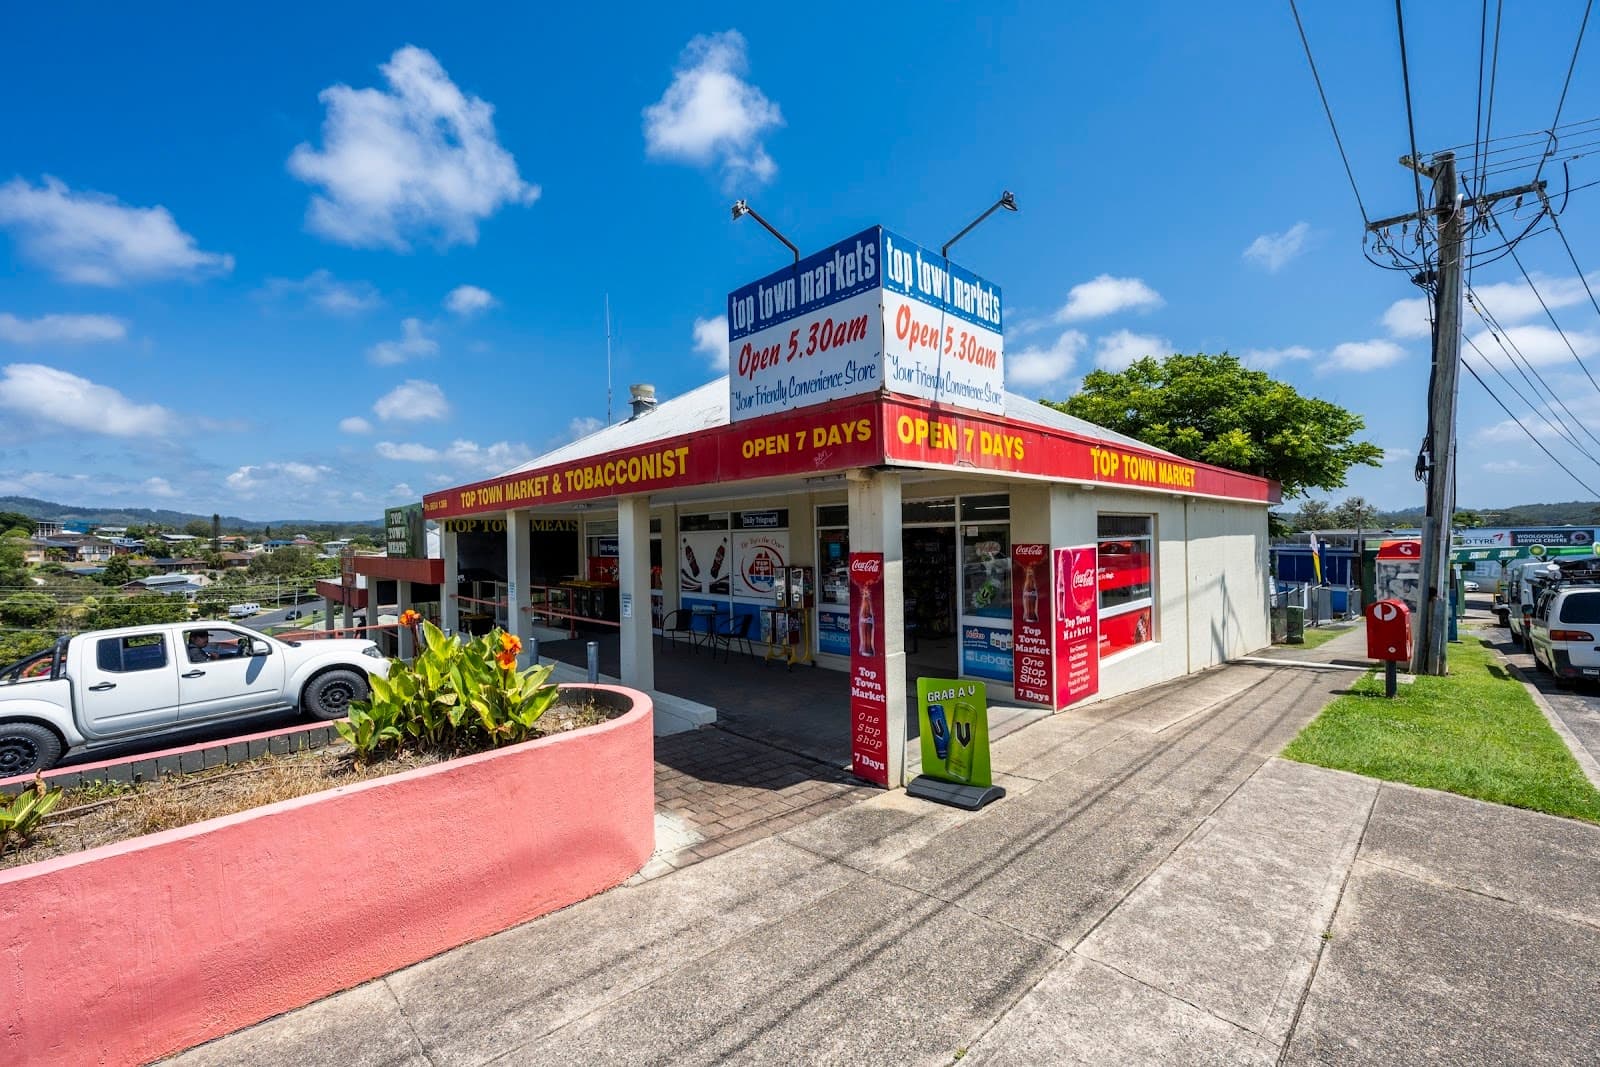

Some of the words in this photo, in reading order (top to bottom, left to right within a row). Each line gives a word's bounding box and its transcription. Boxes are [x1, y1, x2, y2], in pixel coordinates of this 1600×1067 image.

[733, 295, 755, 332] top
[759, 278, 796, 320] town
[800, 240, 876, 304] markets
[886, 237, 913, 289] top
[916, 248, 951, 305] town
[953, 276, 1001, 325] markets
[896, 304, 940, 352] Open
[944, 325, 997, 370] 5.30am
[738, 342, 781, 381] Open
[787, 316, 868, 362] 5.30am
[755, 380, 788, 406] Friendly
[789, 370, 844, 399] Convenience
[946, 371, 984, 400] Convenience
[742, 432, 790, 459] OPEN
[796, 431, 807, 449] 7
[813, 419, 872, 449] DAYS
[897, 415, 958, 451] OPEN
[964, 428, 975, 453] 7
[979, 431, 1025, 460] DAYS
[1090, 447, 1119, 477] TOP
[1122, 454, 1156, 482] TOWN
[1158, 464, 1195, 487] MARKET
[460, 491, 476, 508] TOP
[477, 484, 503, 505] TOWN
[505, 475, 549, 501] MARKET
[553, 473, 563, 494] &
[565, 447, 689, 489] TOBACCONIST
[391, 511, 402, 526] TOP
[531, 518, 578, 531] MEATS
[388, 526, 406, 540] TOWN
[1065, 618, 1076, 629] Top
[1076, 615, 1091, 626] Town
[1022, 626, 1042, 637] Top
[1063, 626, 1092, 640] Markets
[1018, 634, 1047, 646] Town
[1015, 643, 1051, 656] Market
[1021, 656, 1045, 668] One
[859, 667, 877, 681] Top
[1020, 665, 1047, 678] Stop
[854, 677, 882, 691] Town
[1019, 674, 1048, 688] Shop
[851, 687, 886, 703] Market
[927, 688, 955, 702] GRAB
[958, 687, 966, 697] A
[1017, 688, 1025, 697] 7
[1026, 689, 1050, 702] Days
[858, 712, 880, 724] One
[857, 723, 881, 738] Stop
[856, 735, 883, 749] Shop
[854, 752, 861, 763] 7
[862, 755, 885, 771] Days
